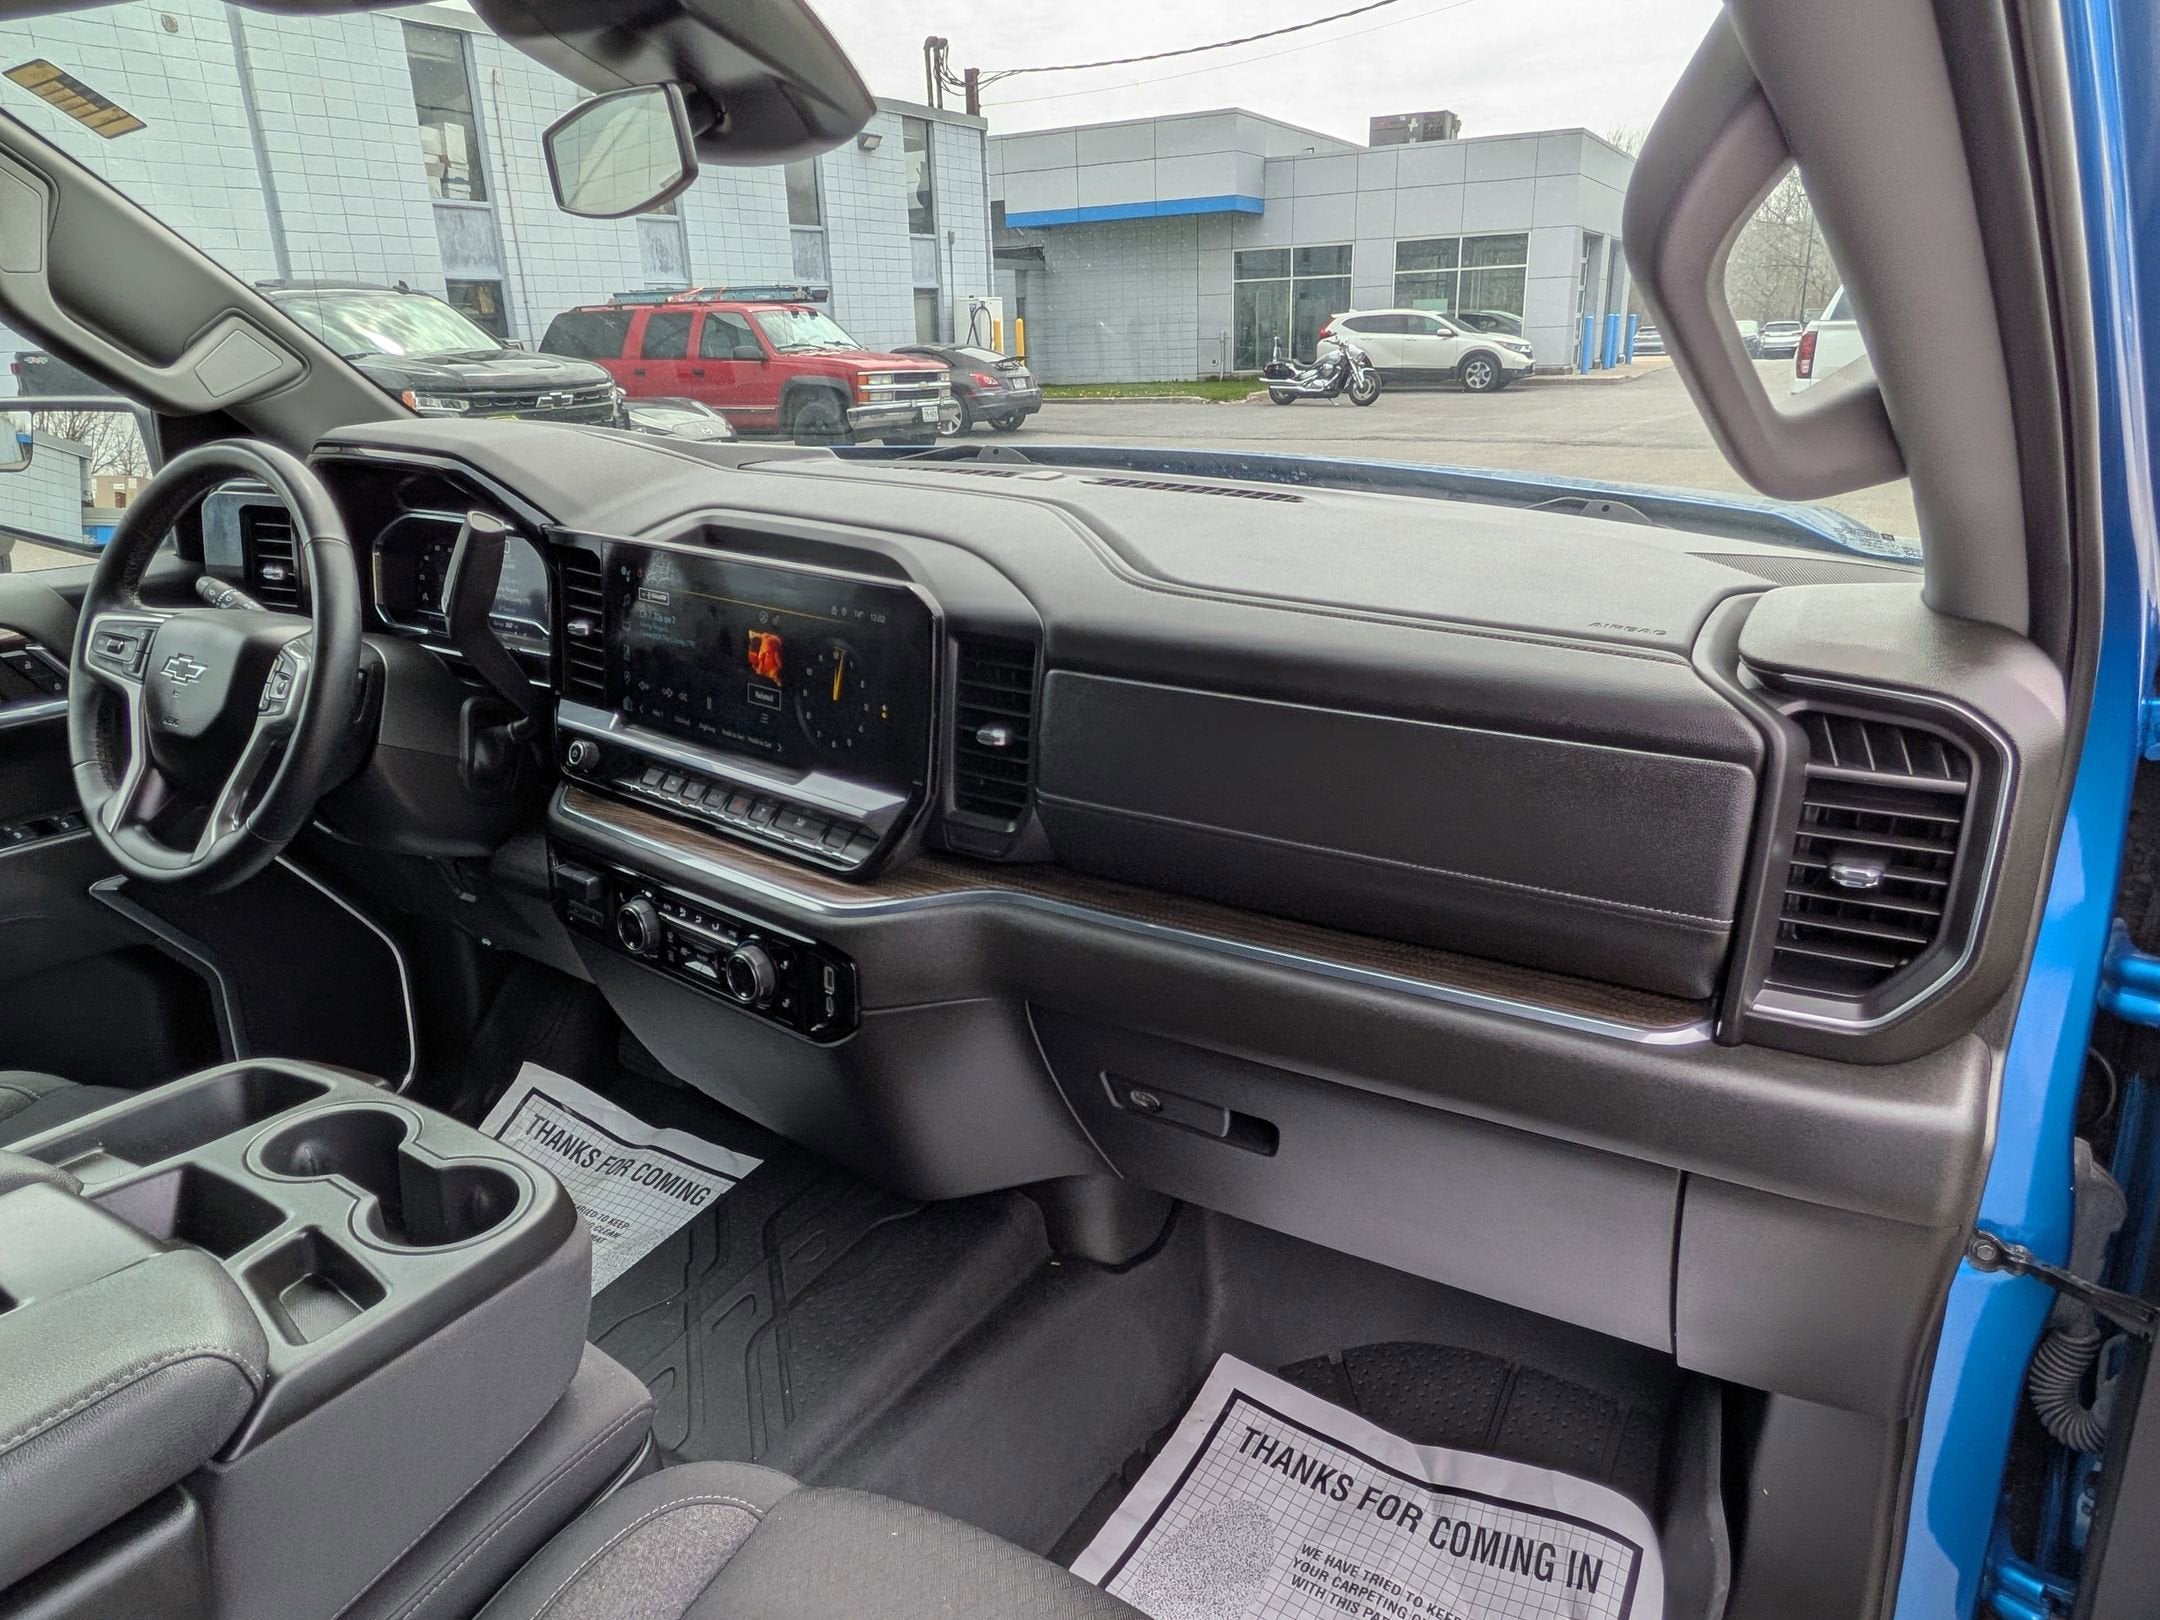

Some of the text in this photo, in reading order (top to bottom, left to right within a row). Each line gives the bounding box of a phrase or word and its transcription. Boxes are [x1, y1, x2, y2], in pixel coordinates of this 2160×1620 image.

[1588, 622, 1667, 636] AIRBAG
[525, 1113, 713, 1208] THANKS FOR COMING
[597, 1213, 610, 1223] TO
[608, 1217, 630, 1229] KEEP
[1237, 1425, 1604, 1595] THANKS FOR COMING IN
[1290, 1574, 1327, 1600] WITH
[1328, 1592, 1361, 1614] THIS
[1292, 1556, 1408, 1620] YOUR CARPETING
[1301, 1543, 1324, 1562] WE
[1324, 1554, 1361, 1578] HAVE
[1362, 1569, 1402, 1597] TRIED
[1405, 1590, 1424, 1608] TO
